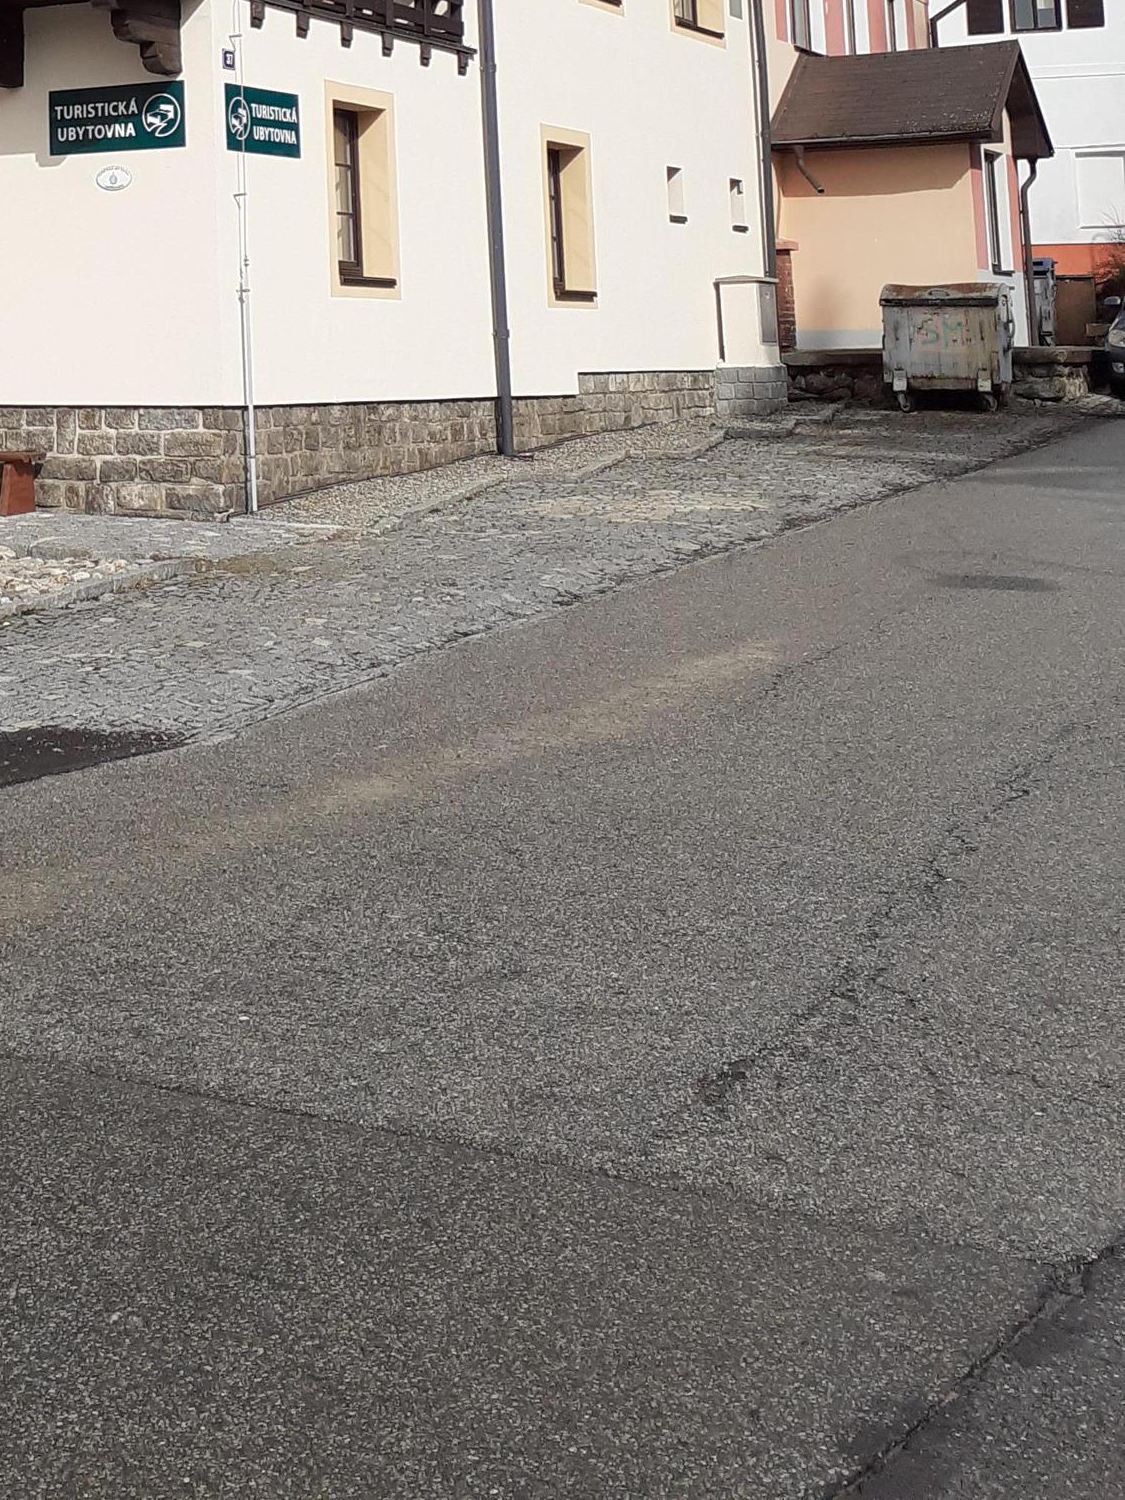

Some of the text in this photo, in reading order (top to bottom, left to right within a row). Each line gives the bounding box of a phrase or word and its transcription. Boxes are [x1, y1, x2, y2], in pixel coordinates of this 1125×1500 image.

[54, 97, 138, 120] TURISTICKÁ
[250, 103, 298, 123] TURISTICKÁ
[57, 122, 136, 142] UBYTOVNA
[253, 125, 297, 145] UBYTOVNA
